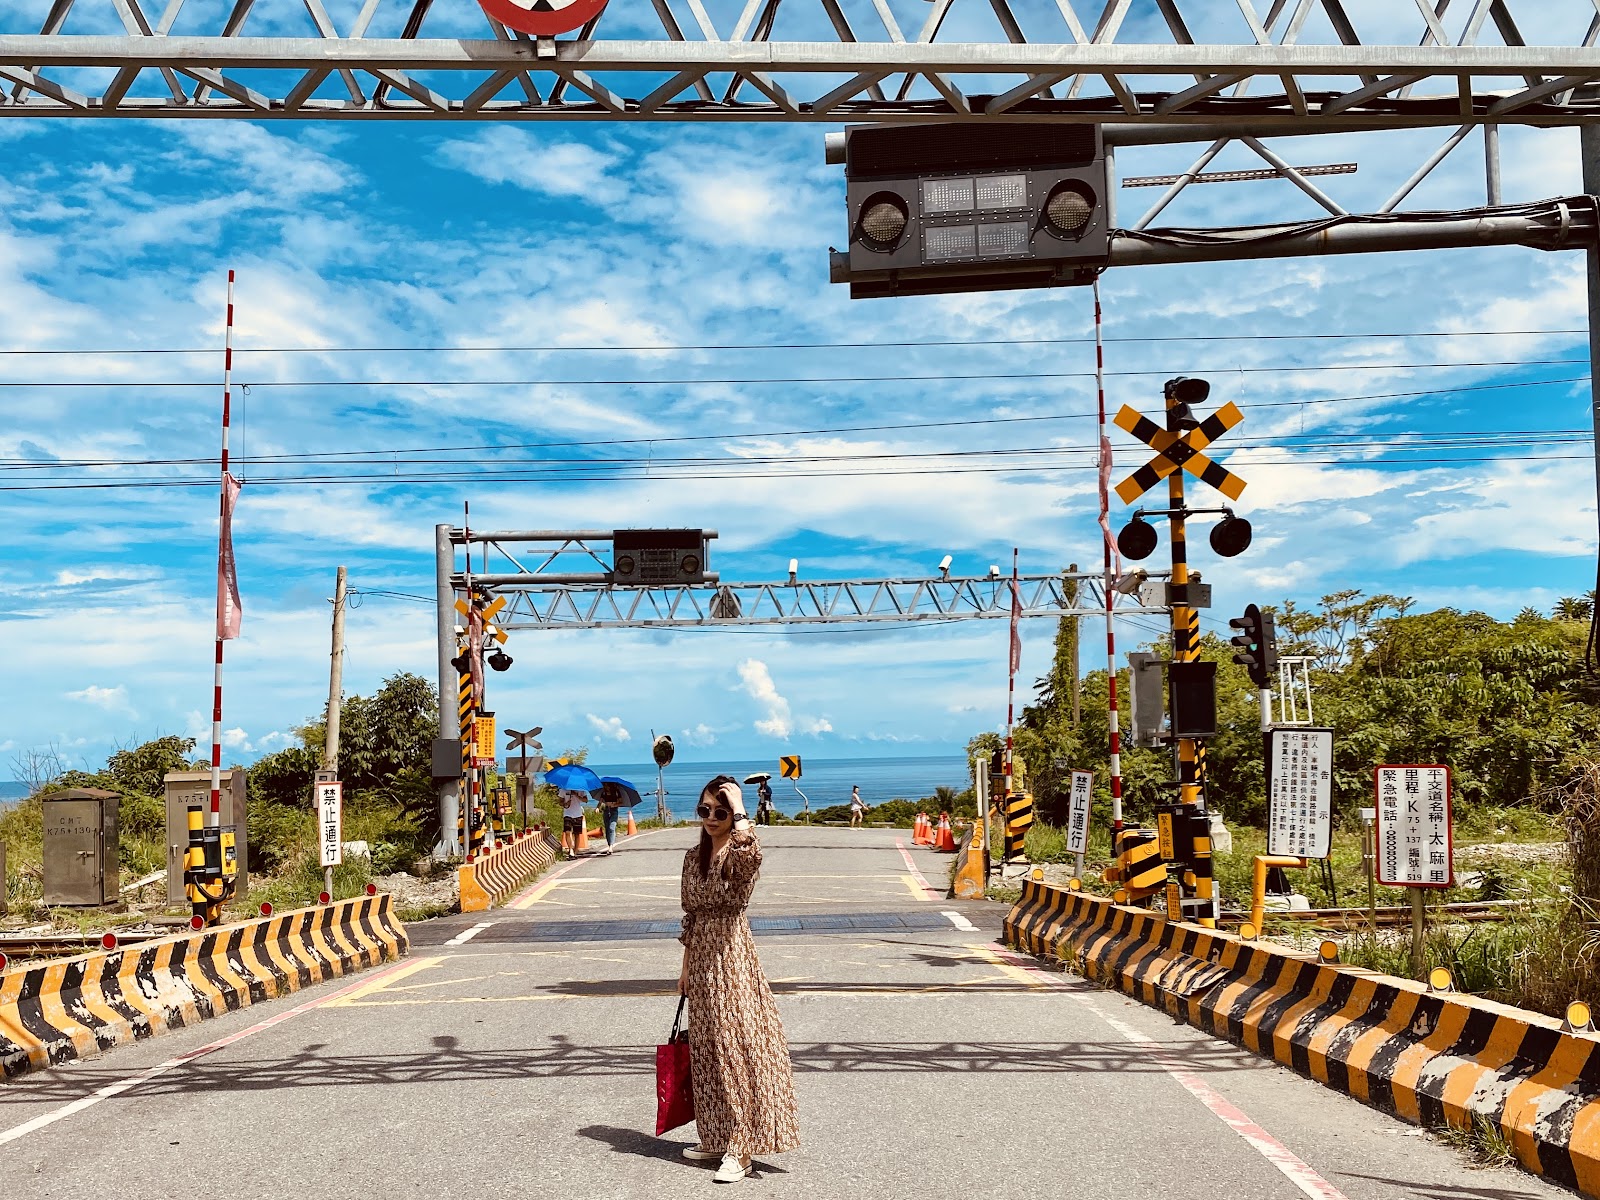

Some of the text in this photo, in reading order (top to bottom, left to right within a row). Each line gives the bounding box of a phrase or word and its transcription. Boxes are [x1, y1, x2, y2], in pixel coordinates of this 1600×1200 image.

[177, 794, 224, 803] K75+17
[1072, 775, 1088, 849] 禁止通行
[1319, 771, 1330, 820] 告示
[323, 788, 337, 862] 禁止通行
[1160, 815, 1172, 858] 緊急按鈕
[1407, 873, 1422, 881] 519
